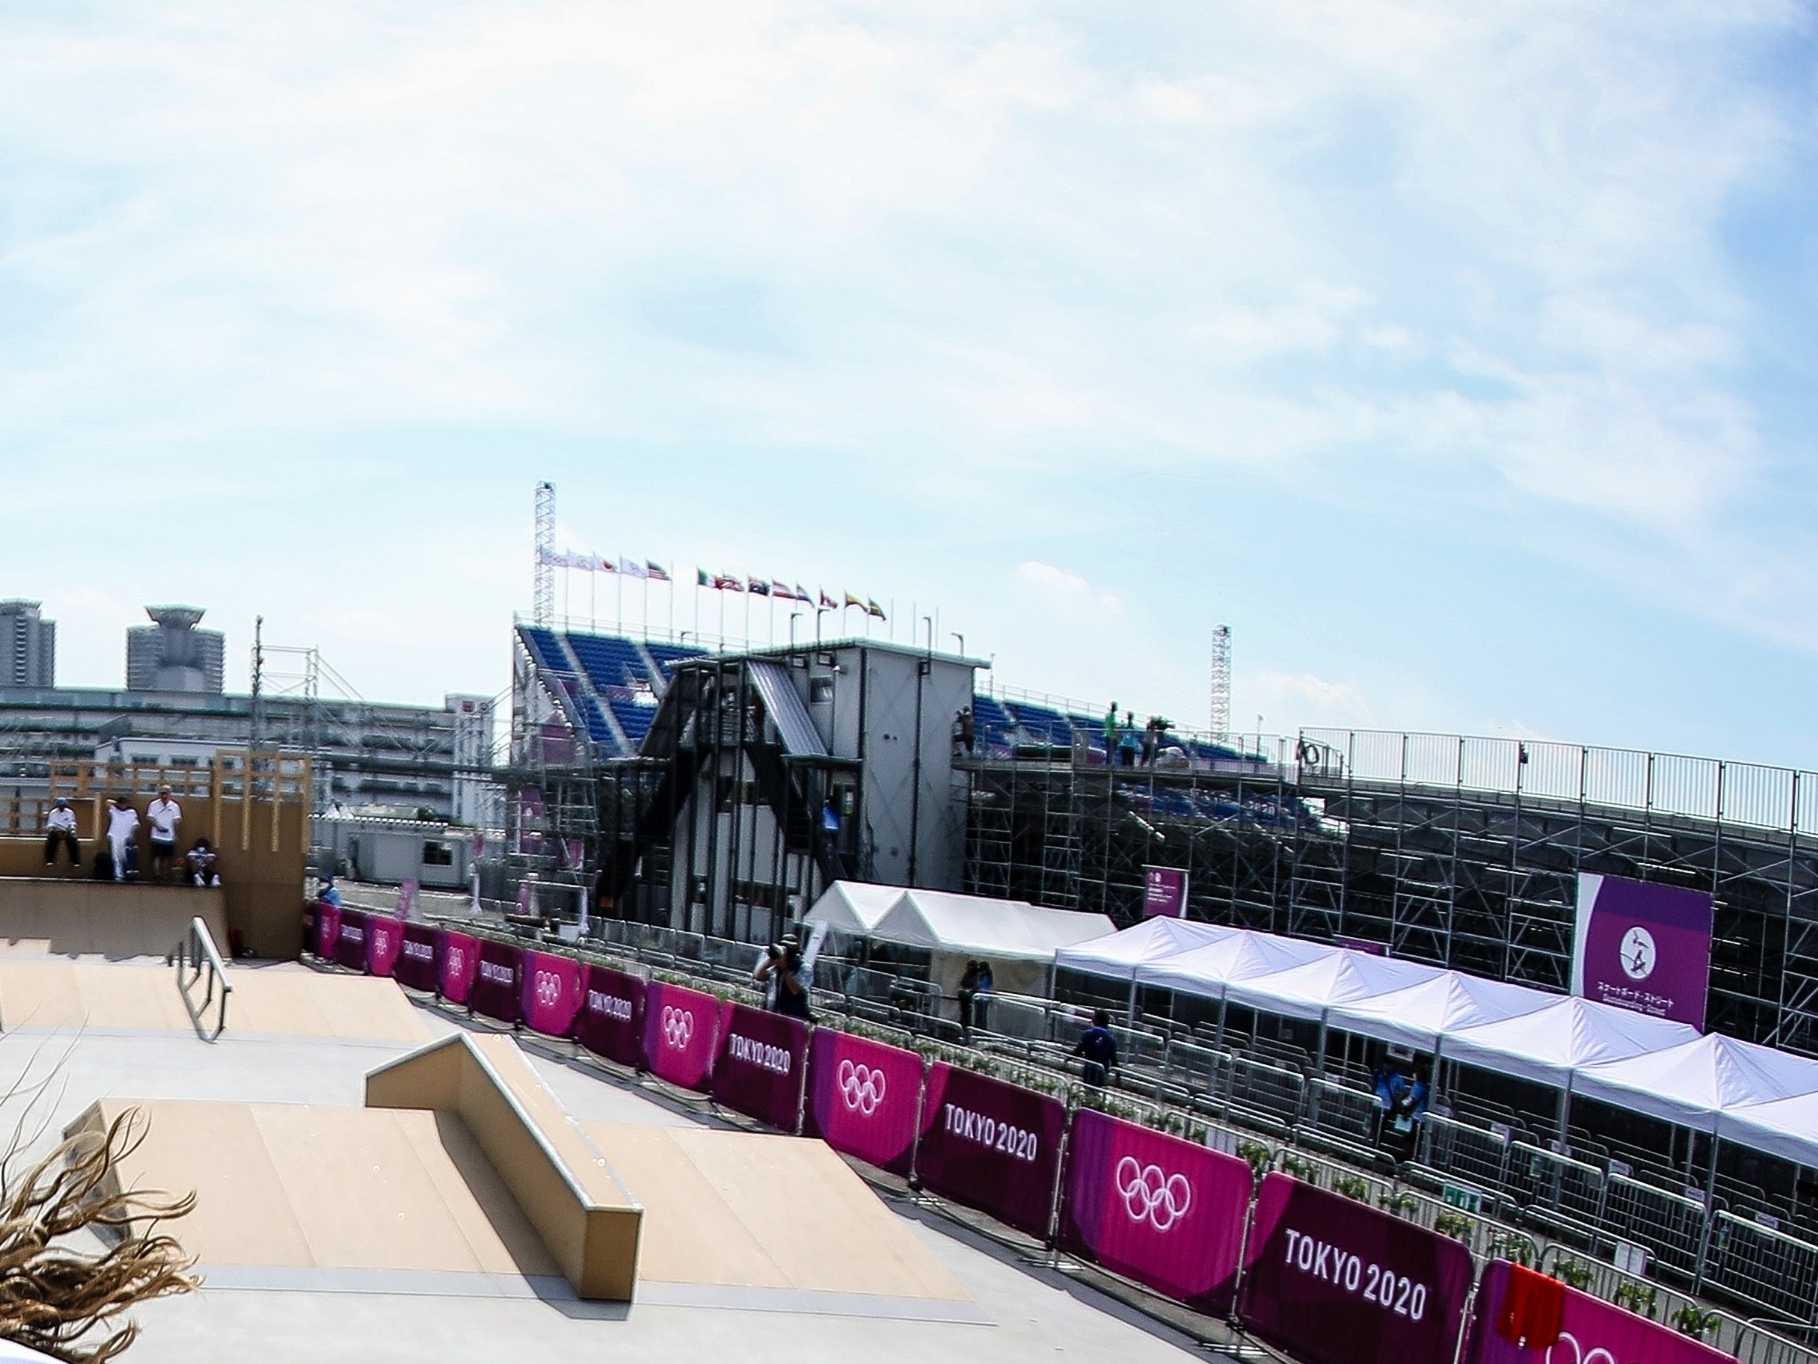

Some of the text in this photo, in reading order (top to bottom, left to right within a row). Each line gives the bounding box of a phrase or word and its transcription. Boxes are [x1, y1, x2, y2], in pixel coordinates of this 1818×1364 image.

[729, 1033, 764, 1063] TOKYO
[945, 1103, 1038, 1161] TOKYO 2020
[1285, 1227, 1426, 1320] TOKYO 2020
